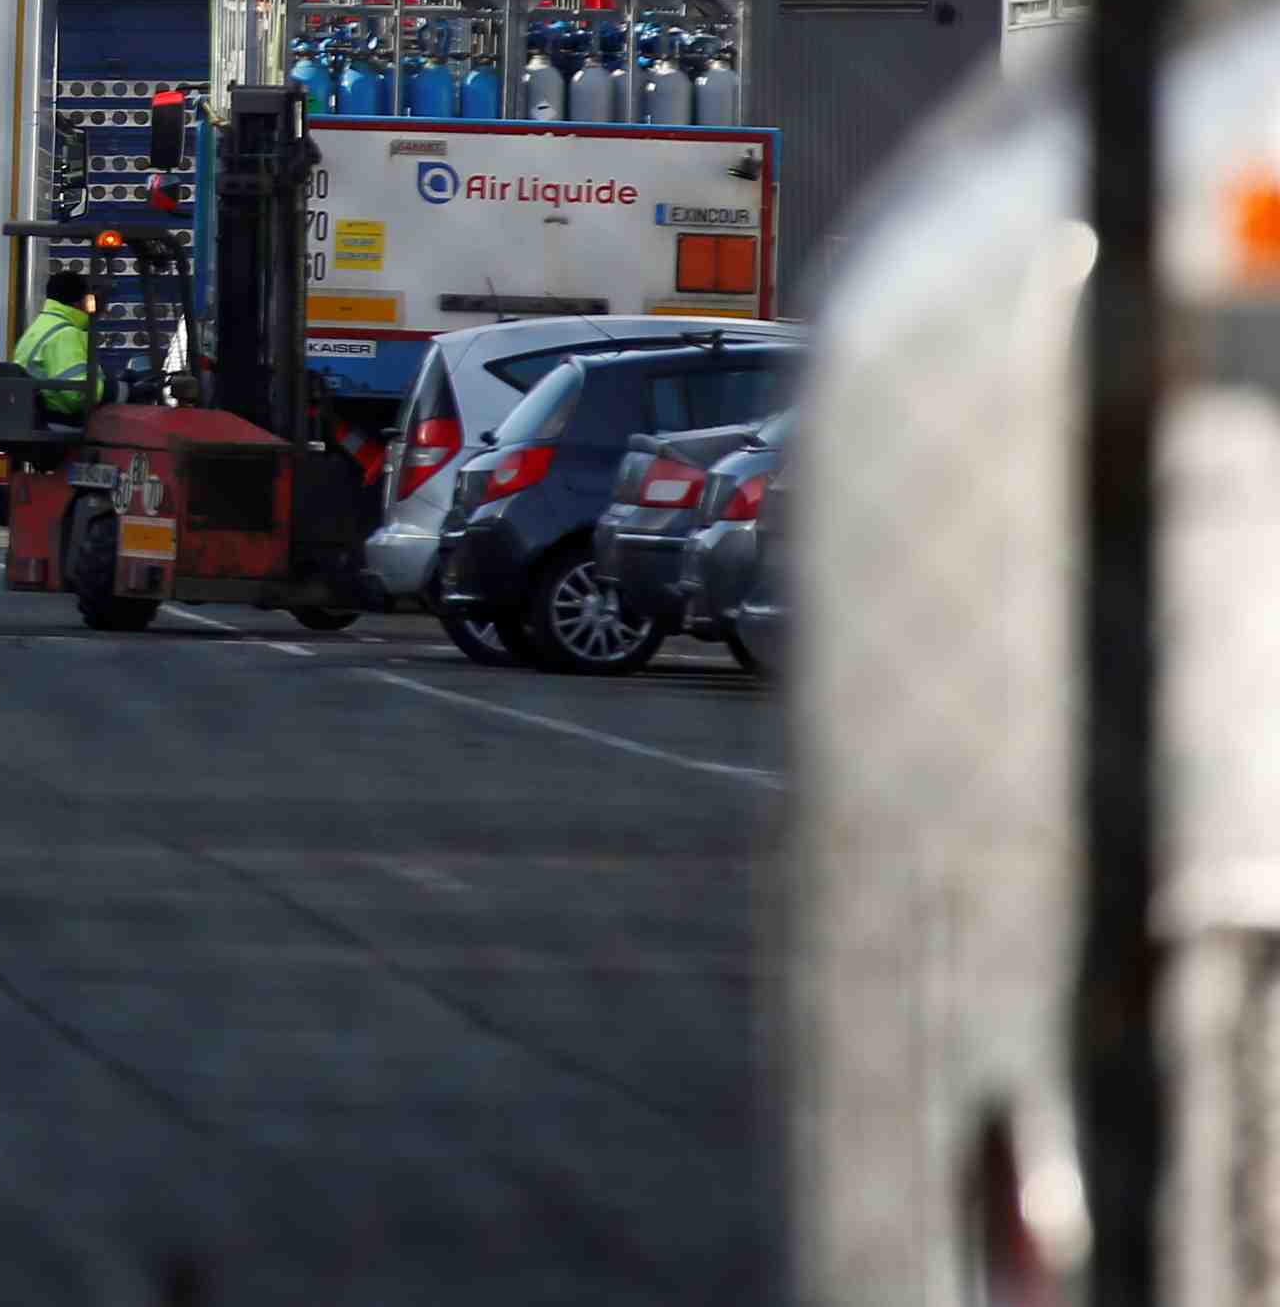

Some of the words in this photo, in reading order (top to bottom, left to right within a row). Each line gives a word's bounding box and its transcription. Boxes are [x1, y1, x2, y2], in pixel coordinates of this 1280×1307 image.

[465, 174, 511, 201] Air
[518, 177, 640, 208] Liquide
[307, 343, 372, 354] KAISER
